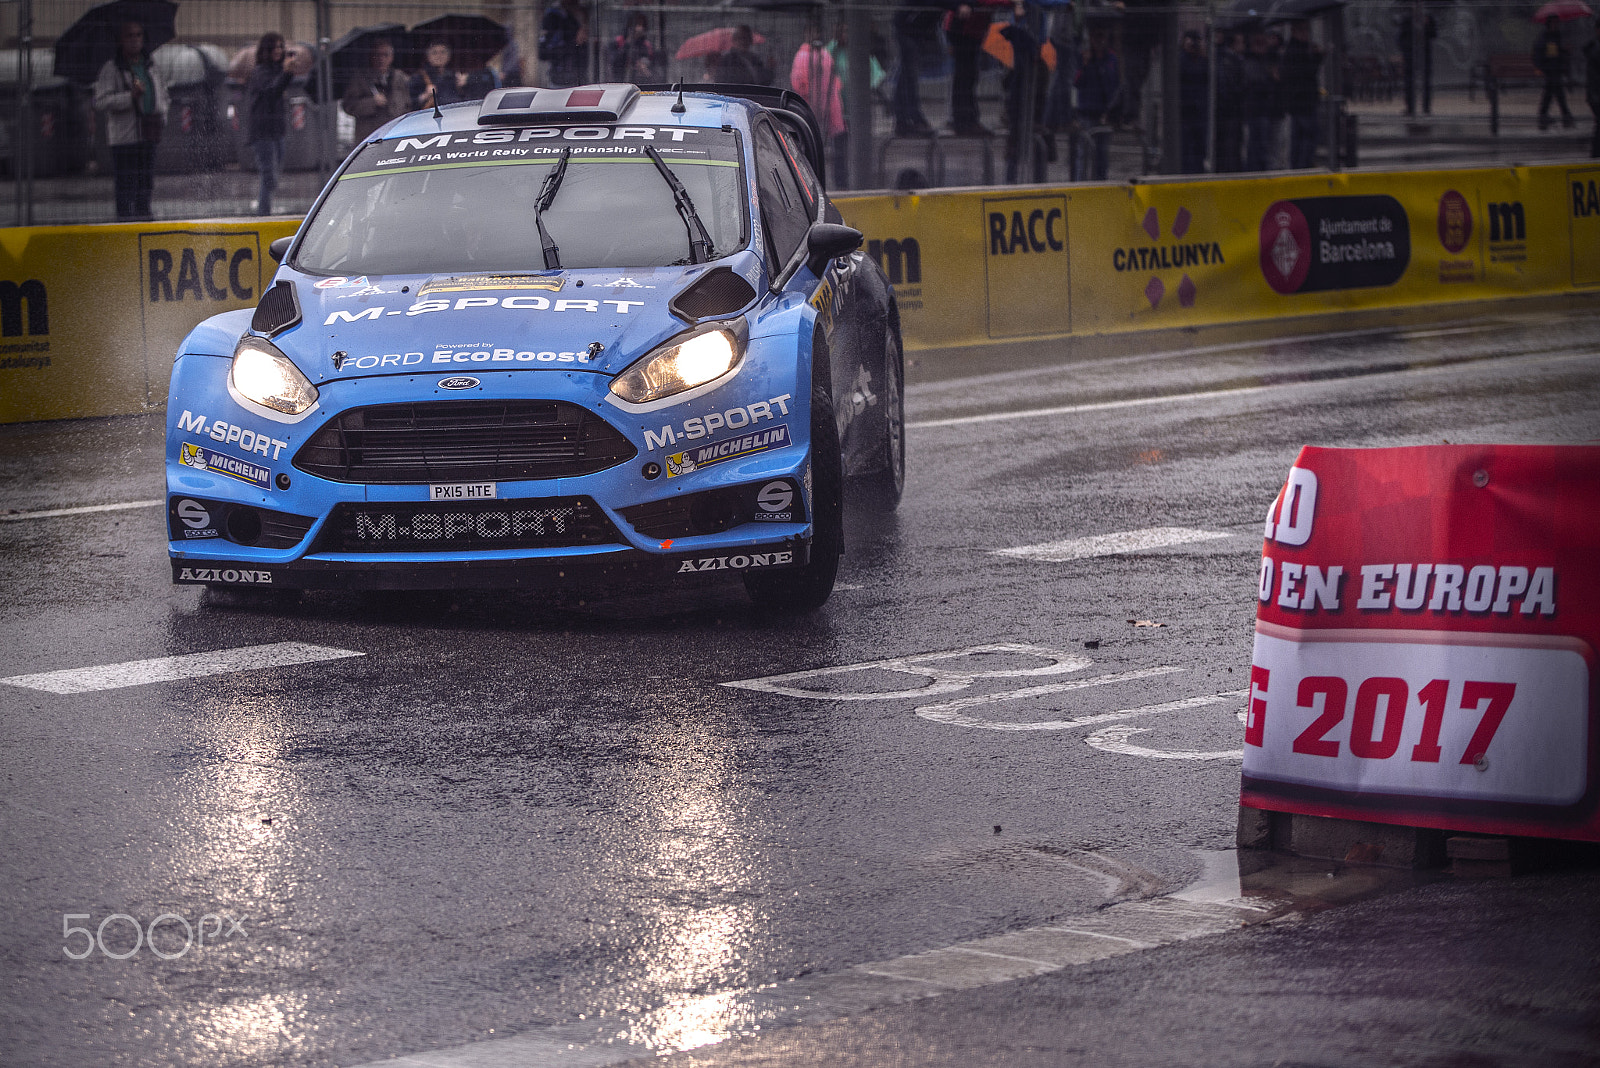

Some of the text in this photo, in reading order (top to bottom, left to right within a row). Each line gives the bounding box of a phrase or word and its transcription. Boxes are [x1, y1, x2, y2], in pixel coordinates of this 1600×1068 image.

[394, 127, 699, 152] M-SPORT
[418, 154, 441, 162] FIA
[446, 150, 488, 159] World
[493, 148, 529, 156] Rally
[989, 208, 1064, 255] RACC
[1319, 216, 1392, 239] Ajuntament de
[1112, 242, 1225, 271] CATALUNYA
[1320, 239, 1395, 263] Barcelona
[149, 247, 254, 302] RACC
[323, 296, 645, 326] M-SPORT
[338, 349, 589, 371] FORD EcoBoost
[177, 410, 288, 461] M-SPORT
[643, 393, 791, 451] M-SPORT
[698, 428, 785, 462] MICHELIN
[209, 454, 269, 483] MICHELIN
[467, 485, 492, 497] HTE
[356, 507, 575, 540] M-SPORT
[755, 512, 792, 520] sparco
[179, 567, 273, 584] AZIONE
[677, 551, 793, 573] AZIONE
[1277, 561, 1344, 611] EN
[1357, 563, 1556, 615] EUROPA
[1292, 676, 1517, 766] 2017
